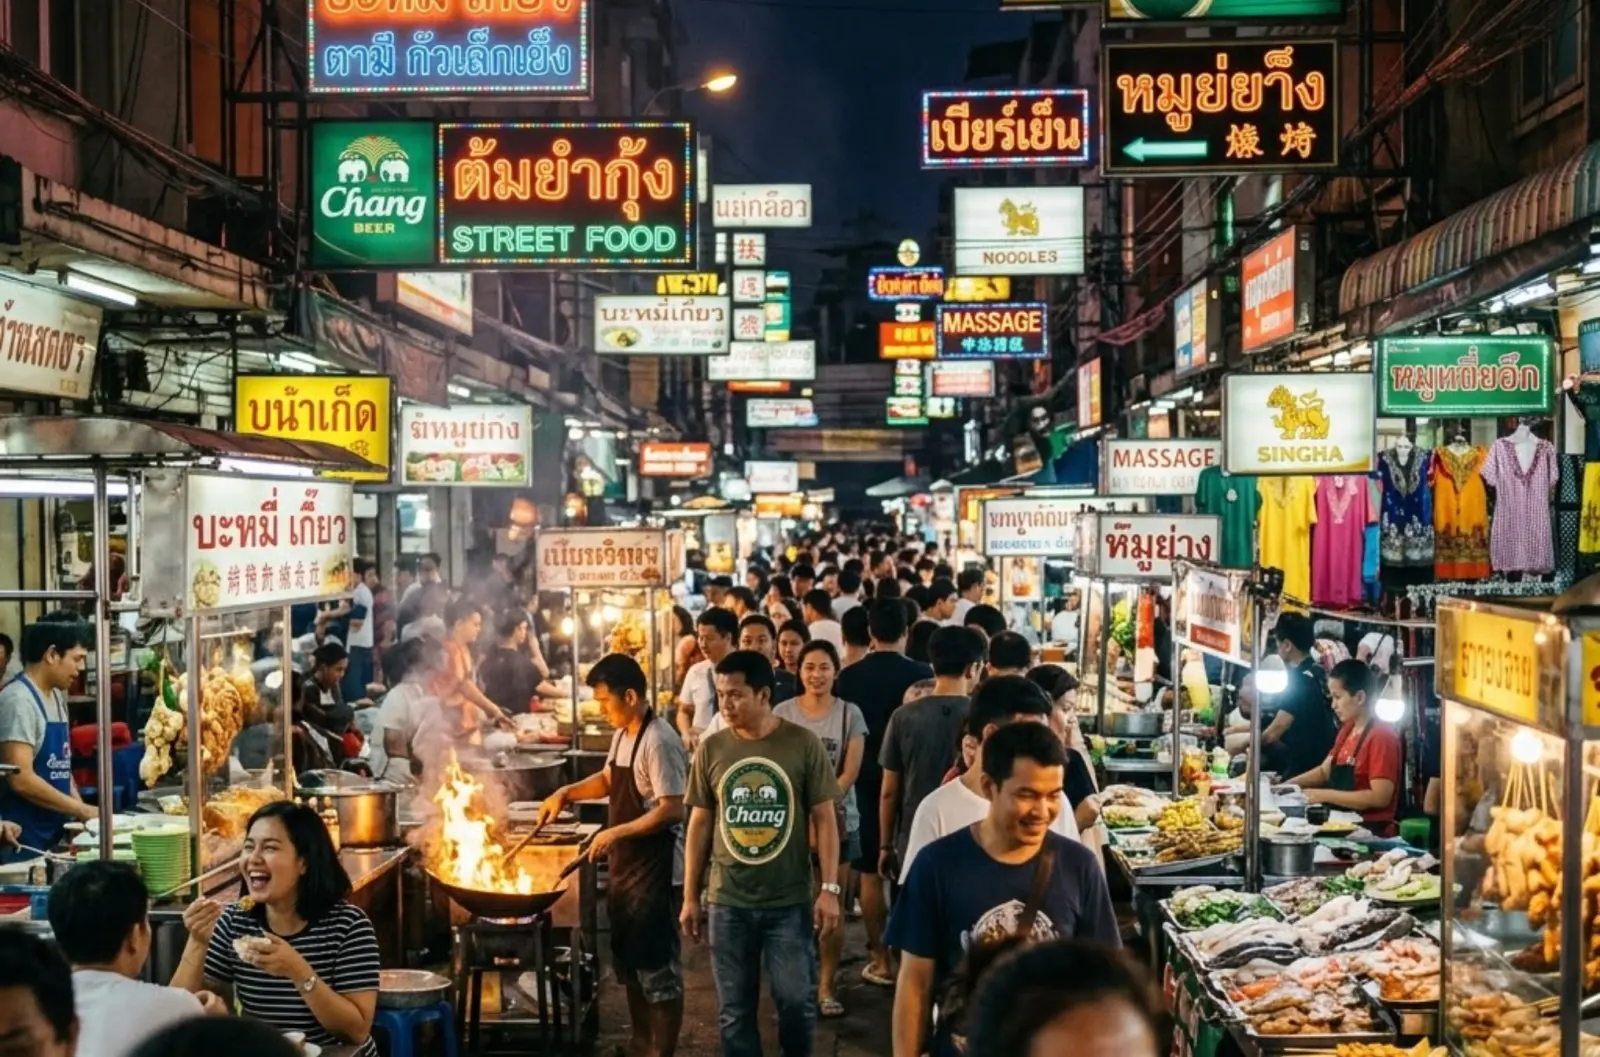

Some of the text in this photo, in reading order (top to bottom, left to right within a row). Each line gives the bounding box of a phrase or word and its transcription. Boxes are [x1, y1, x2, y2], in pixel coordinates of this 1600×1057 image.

[931, 98, 1081, 152] เบียร์เย็น
[453, 136, 674, 222] ต้มยำกุ้ง
[320, 186, 427, 225] Chang
[353, 222, 395, 234] BEER
[452, 225, 677, 253] STREET FOOD
[943, 310, 1042, 333] MASSAGE
[1113, 448, 1215, 468] MASSAGE
[1257, 445, 1345, 463] SINGHA
[725, 804, 786, 828] Chang
